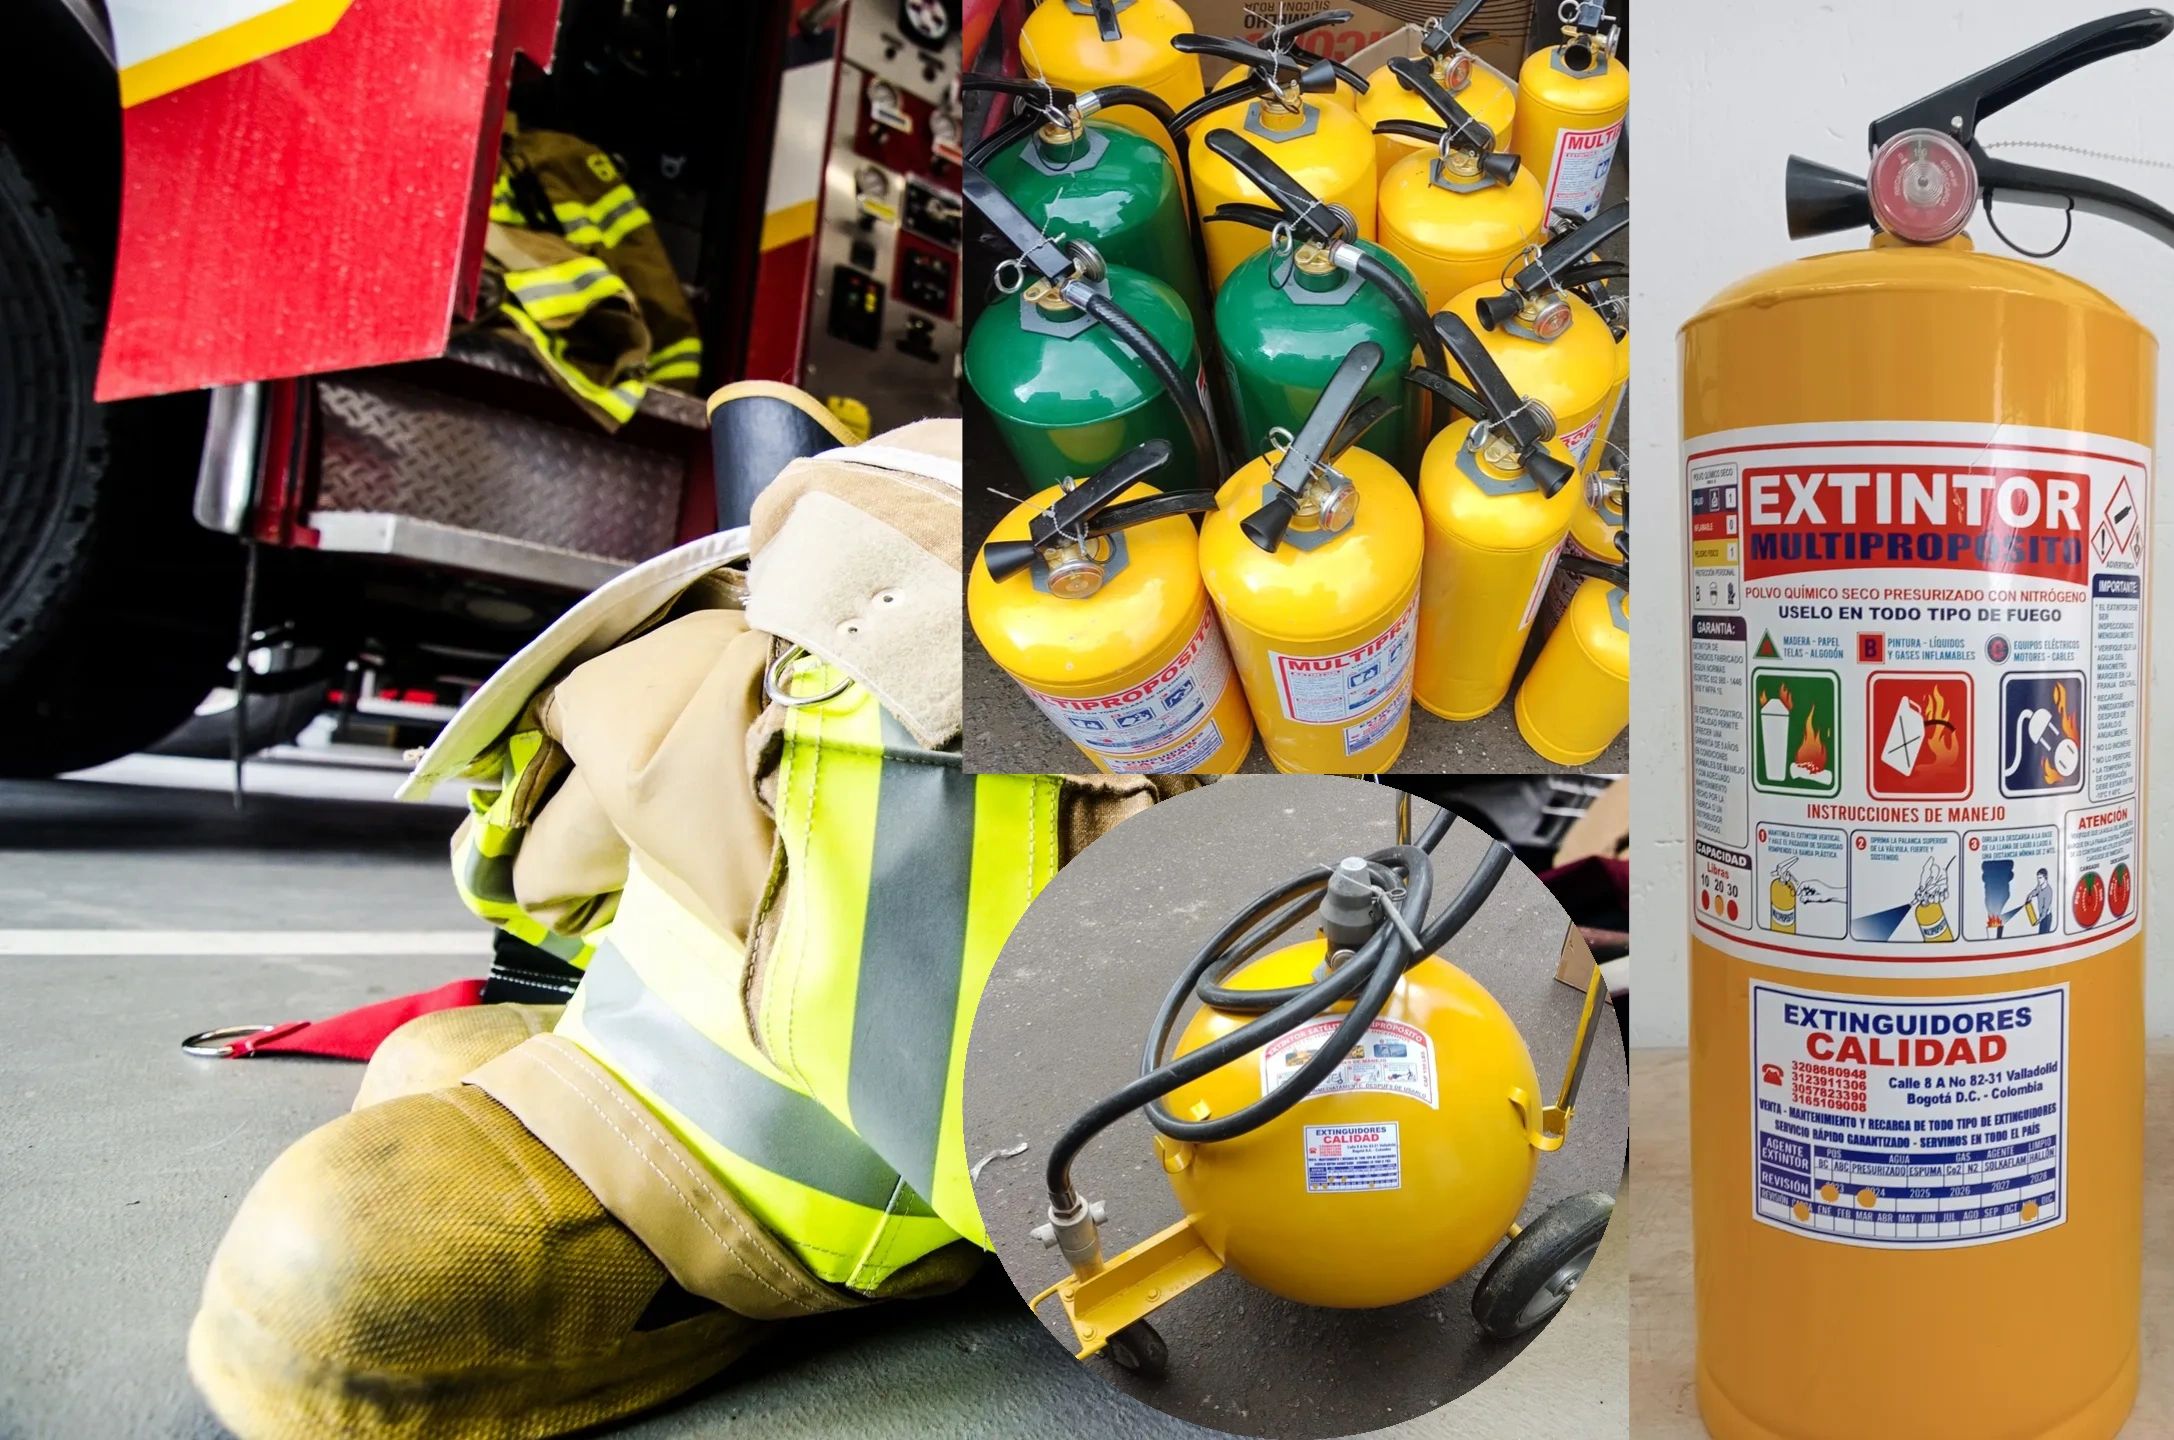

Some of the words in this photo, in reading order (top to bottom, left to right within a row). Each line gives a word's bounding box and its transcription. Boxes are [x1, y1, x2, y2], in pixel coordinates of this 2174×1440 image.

[1750, 472, 2083, 531] EXTINTOR
[1745, 587, 1781, 599] POLVO
[1784, 584, 1838, 600] QUÍMICO
[1842, 587, 1880, 600] SECO
[1884, 588, 1984, 601] PRESURIZADO
[1988, 589, 2017, 602] CON
[2021, 588, 2087, 603] NITRÓGENO
[1779, 606, 1833, 619] USELO
[1839, 607, 1863, 620] EN
[1869, 607, 1921, 621] TODO
[1928, 608, 1971, 621] TIPO
[1978, 608, 2001, 621] DE
[2007, 609, 2061, 622] FUEGO
[1783, 636, 1810, 646] MADERA
[1818, 637, 1840, 647] PAPEL
[1864, 639, 1876, 658] B
[1888, 638, 1920, 648] PINTURA
[1929, 635, 1965, 648] LÍQUIDOS
[2014, 641, 2042, 650] EQUIPOS
[2044, 638, 2080, 650] ELÉCTRICOS
[1784, 648, 1803, 658] TELAS
[1810, 647, 1843, 659] ALGODÓN
[1888, 651, 1893, 660] Y
[1895, 651, 1920, 660] GASES
[1922, 651, 1976, 661] INFLAMABLES
[2014, 652, 2045, 662] MOTORES
[2052, 652, 2075, 661] CABLES
[1807, 804, 1918, 823] INSTRUCCIONES
[1925, 808, 1942, 823] DE
[1948, 806, 2006, 823] MANEJO
[2078, 807, 2128, 830] ATENCIÓN
[1697, 842, 1747, 867] CAPACIDAD
[1701, 873, 1709, 887] 10
[1715, 879, 1724, 893] 20
[1727, 883, 1738, 898] 30
[1784, 1003, 2032, 1036] EXTINGUIDORES
[1807, 1032, 2007, 1067] CALIDAD
[1792, 1071, 1867, 1091] 3123911306
[1889, 1077, 1920, 1089] Calle
[1924, 1077, 1932, 1089] 8
[1936, 1077, 1946, 1088] A
[1949, 1076, 1966, 1088] No
[1970, 1072, 2002, 1086] 82-31
[2006, 1061, 2058, 1083] Valladolid
[1907, 1092, 1951, 1108] Bogotá
[1956, 1091, 1980, 1103] D.C.
[1992, 1081, 2043, 1099] Colombia
[1759, 1098, 1782, 1115] VENTA
[1789, 1106, 1857, 1128] MANTENIMIENTO
[1860, 1118, 1865, 1129] Y
[1868, 1119, 1911, 1132] RECARGA
[1914, 1119, 1925, 1131] DE
[1929, 1119, 1953, 1131] TODO
[1957, 1117, 1977, 1129] TIPO
[1981, 1115, 1992, 1127] DE
[1995, 1102, 2057, 1126] EXTINGUIDORES
[1316, 1126, 1387, 1136] EXTINGUIDORES
[1323, 1134, 1379, 1144] CALIDAD
[1775, 1119, 1809, 1138] SERVICIO
[1812, 1127, 1844, 1143] RÁPIDO
[1847, 1134, 1910, 1149] GARANTIZADO
[1920, 1136, 1968, 1148] SERVIMOS
[1971, 1134, 1982, 1146] EN
[1985, 1130, 2008, 1144] TODO
[2011, 1127, 2019, 1139] EL
[2022, 1121, 2040, 1138] PAÍS
[1766, 1138, 1803, 1157] AGENTE
[1889, 1155, 1910, 1164] AGUA
[1956, 1152, 1971, 1162] GAS
[1987, 1145, 2014, 1159] AGENTE
[2028, 1137, 2051, 1151] LIMPIO
[1762, 1147, 1809, 1170] EXTINTOR
[1834, 1162, 1850, 1172] ABC
[1852, 1163, 1906, 1176] PRESURIZADO
[1909, 1166, 1942, 1176] ESPUMA
[1968, 1163, 1979, 1173] N2
[1985, 1155, 2027, 1172] SOLKAFLAM
[1762, 1171, 1809, 1195] REVISIÓN
[1910, 1188, 1931, 1198] 2025
[1950, 1186, 1971, 1197] 2026
[1992, 1181, 2010, 1191] 2027
[1818, 1205, 1832, 1215] ENE
[1837, 1208, 1851, 1218] FEB
[1856, 1211, 1872, 1221] MAR
[1877, 1213, 1893, 1222] ABR
[1898, 1212, 1915, 1223] MAY
[1921, 1213, 1936, 1222] JUN
[1963, 1210, 1979, 1220] AGO
[1984, 1207, 1999, 1217] SEP
